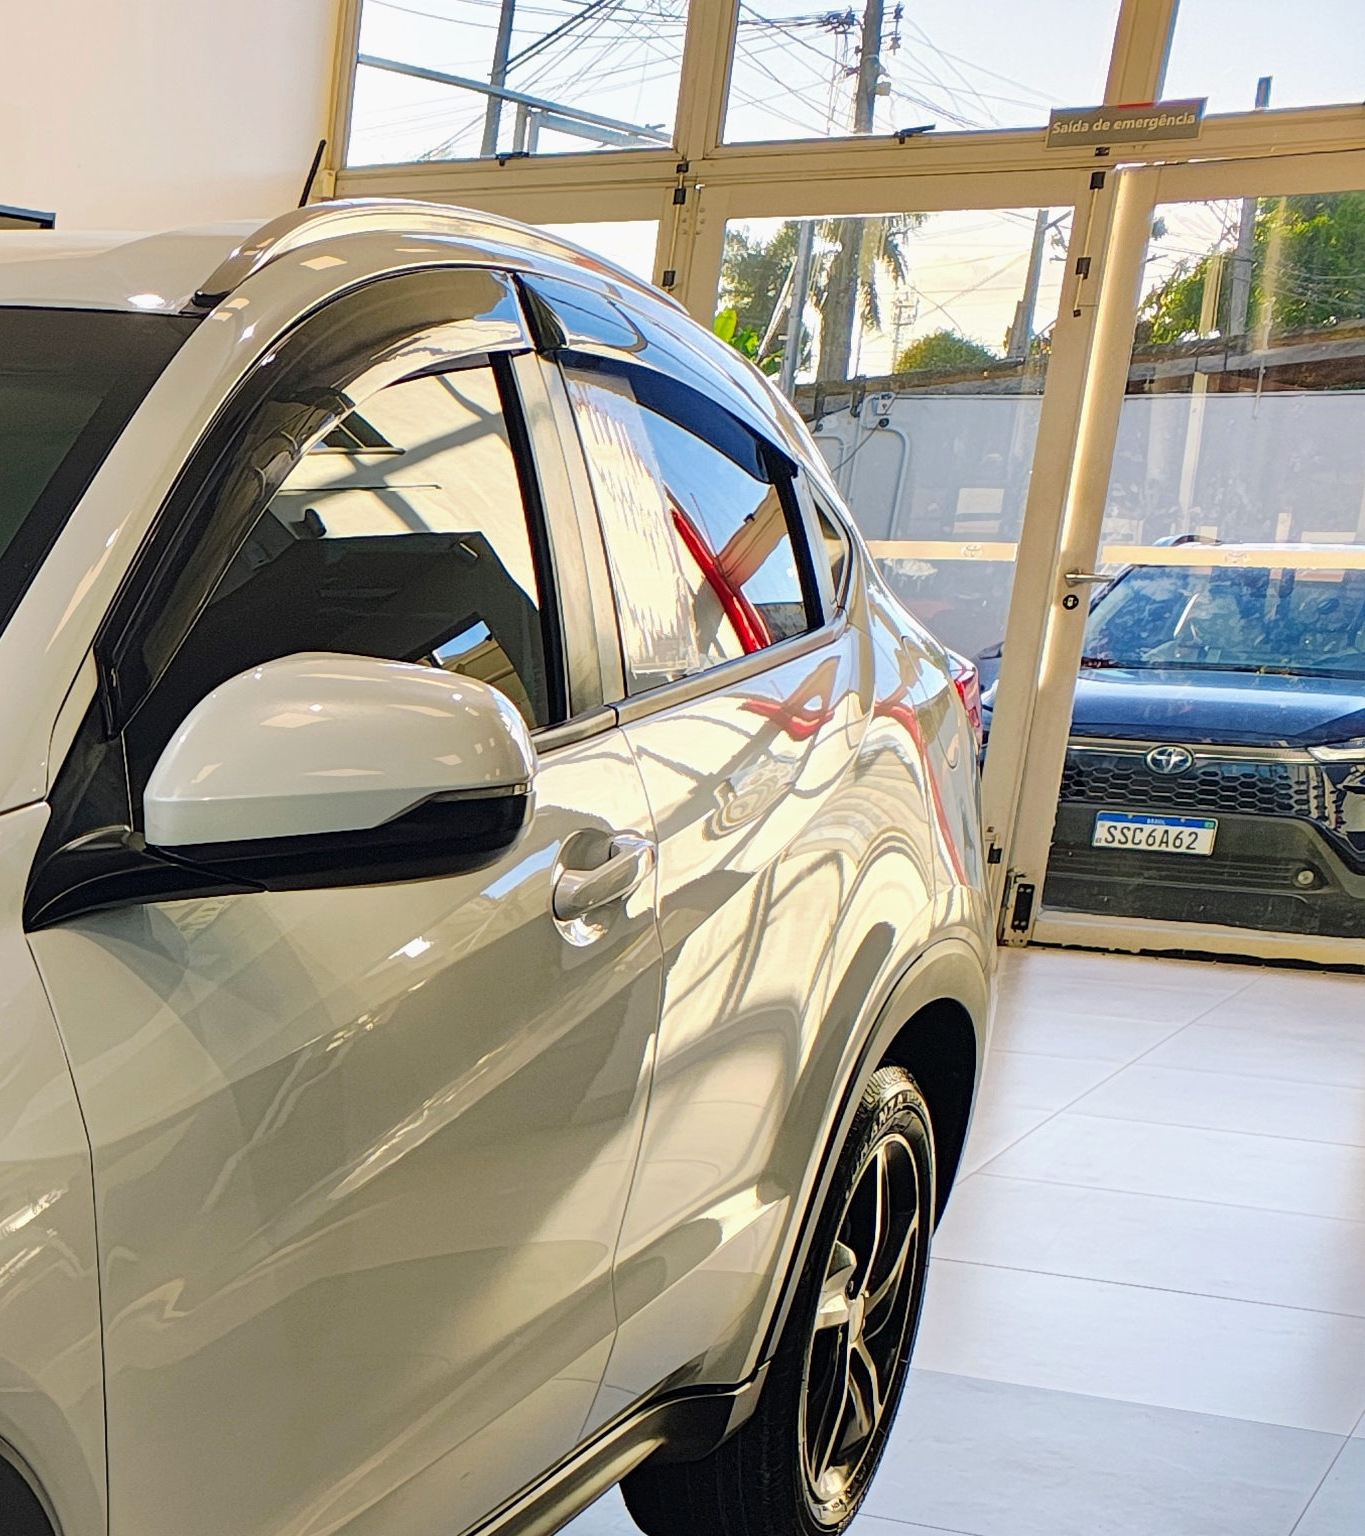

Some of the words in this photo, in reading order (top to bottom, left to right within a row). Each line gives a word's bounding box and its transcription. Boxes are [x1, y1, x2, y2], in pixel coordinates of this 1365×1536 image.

[1053, 119, 1089, 134] Saída
[1093, 118, 1110, 131] de
[1113, 113, 1195, 131] emergência
[1104, 825, 1199, 850] SSC6A62
